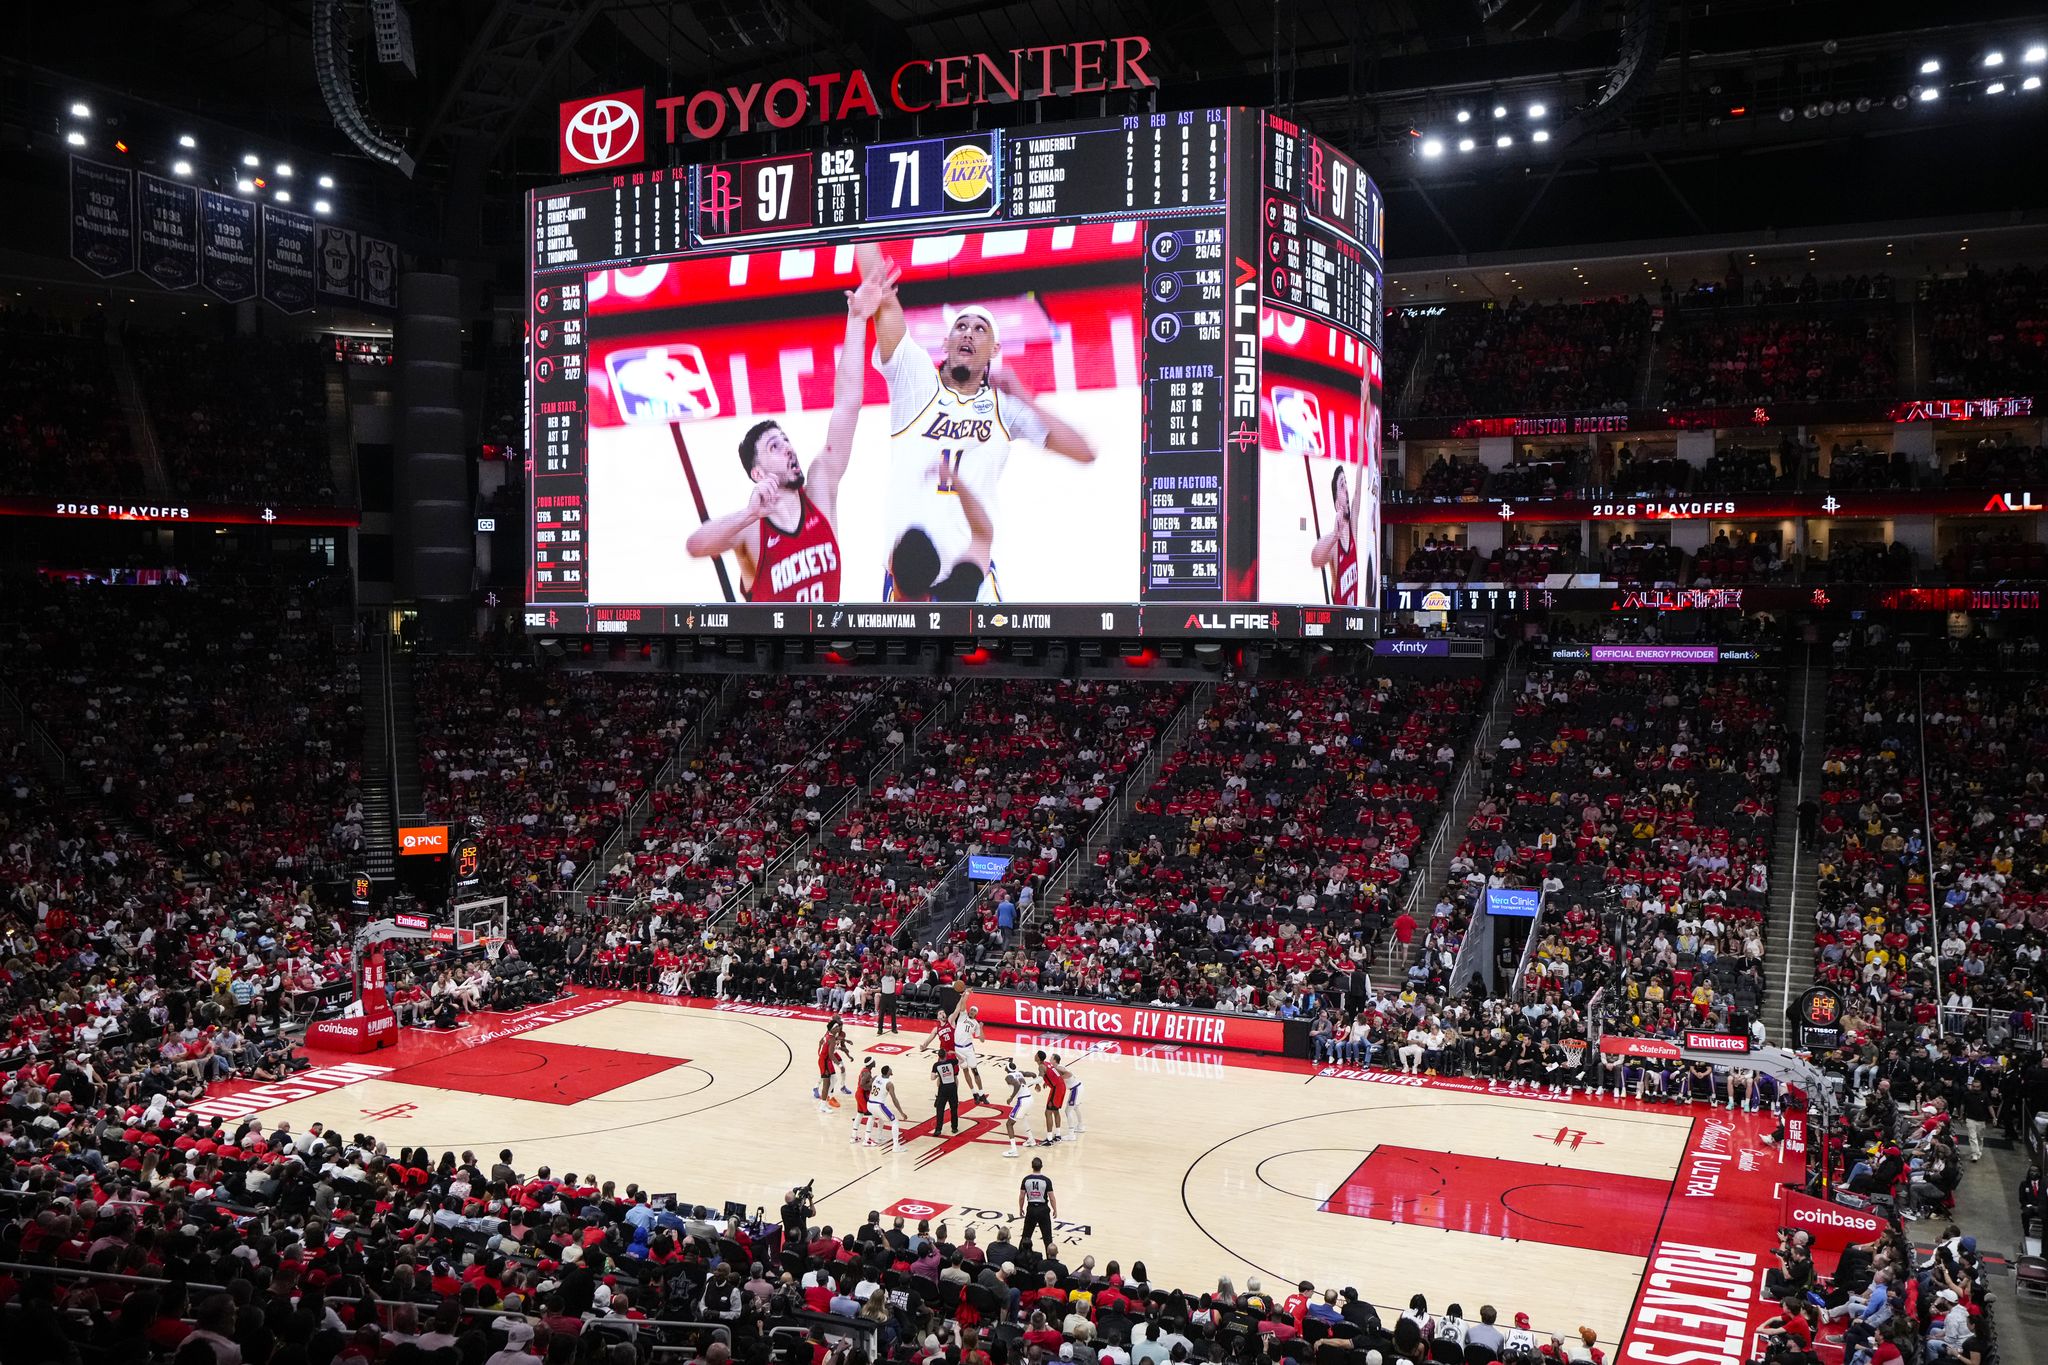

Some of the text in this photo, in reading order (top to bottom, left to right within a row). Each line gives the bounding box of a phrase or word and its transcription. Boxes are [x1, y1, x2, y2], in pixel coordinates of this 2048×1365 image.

[656, 35, 1155, 144] TOYOTA CENTER
[1123, 109, 1221, 129] PTS REB AST FLS
[1028, 136, 1077, 153] VANDERBILT
[821, 149, 855, 176] 8:52
[1015, 155, 1055, 170] 11 HAYES
[613, 168, 683, 188] PTS REB AST FLS
[889, 150, 920, 209] 71
[1014, 168, 1065, 186] 10 KENNARD
[757, 164, 794, 222] 97
[832, 183, 846, 197] TOL
[1013, 184, 1055, 201] 23 JAMES
[1332, 160, 1348, 219] 97
[547, 196, 571, 211] HOLIDAY
[832, 197, 846, 210] FLS
[1013, 200, 1057, 216] 36 SMART
[86, 204, 119, 222] WNBA
[547, 207, 586, 225] FINNEY-SMITH
[833, 210, 844, 223] CC
[75, 215, 129, 237] Champions
[153, 219, 184, 237] WNBA
[217, 223, 242, 238] 1999
[143, 231, 195, 253] Champions
[214, 234, 244, 251] WNBA
[279, 237, 302, 251] 2000
[547, 237, 565, 251] SMITH
[1160, 239, 1172, 254] 2P
[205, 246, 253, 265] Champions
[276, 248, 304, 264] WNBA
[547, 249, 578, 264] THOMPSON
[267, 259, 313, 278] Champions
[1160, 280, 1172, 294] 3P
[1202, 285, 1221, 300] 2/14
[1161, 320, 1171, 335] FT
[1198, 326, 1221, 341] 13/15
[1234, 256, 1257, 418] ALL FIRE
[540, 364, 548, 376] FT
[1159, 365, 1214, 380] TEAM STATS
[1170, 383, 1187, 397] REB
[541, 400, 577, 414] TEAM STATS
[1170, 399, 1187, 413] AST
[921, 412, 993, 442] LAKERS
[1170, 416, 1185, 429] STL
[1514, 415, 1629, 436] HOUSTON ROCKETS
[547, 430, 569, 442] AST 17
[1170, 432, 1186, 446] BLK
[547, 445, 558, 456] STL
[1153, 475, 1218, 490] FOUR FACTORS
[537, 495, 581, 508] FOUR FACTORS
[1152, 494, 1174, 507] EFG%
[1984, 492, 2043, 511] ALL
[57, 504, 190, 518] 2026 PLAYOFFS
[1593, 502, 1736, 516] 2026 PLAYOFFS
[479, 520, 494, 531] CC
[1152, 517, 1181, 531] OREB%
[1152, 540, 1168, 554] FTR
[770, 542, 837, 595] ROCKETS
[1152, 564, 1175, 577] TOV%
[1399, 591, 1412, 609] 71
[1972, 590, 2040, 609] HOUSTON
[597, 609, 641, 621] DAILY LEADERS
[674, 613, 784, 628] 1. J. ALLEN 15
[817, 613, 941, 629] 2. V. WEMBANYAMA 12
[977, 613, 1114, 630] 3. D. AYTON 10
[1184, 614, 1269, 629] ALL FIRE
[596, 620, 628, 633] REBOUNDS
[1392, 641, 1428, 653] xfinity
[1553, 648, 1748, 660] reliant OFFICIAL ENERGY PROVIDER reliant
[417, 835, 442, 846] PNC
[460, 857, 477, 876] 24
[971, 860, 986, 870] Vera
[356, 887, 367, 896] 24
[1490, 894, 1535, 906] Vera Clinic
[397, 915, 427, 928] Emirates
[1813, 997, 1835, 1008] 8:52
[467, 999, 623, 1045] Michelob ULTRA
[1014, 999, 1226, 1044] Emirates FLY BETTER
[1811, 1008, 1831, 1021] 24
[318, 1022, 359, 1036] coinbase
[370, 1016, 393, 1032] PLAYOFFS
[1814, 1027, 1839, 1035] TISSOT
[1689, 1034, 1745, 1049] Emirates
[941, 1065, 950, 1073] 24
[871, 1085, 881, 1097] 36
[1335, 1069, 1428, 1087] PLAYOFFS
[1432, 1080, 1473, 1090] Presented
[1487, 1087, 1572, 1101] Google
[1789, 1120, 1803, 1130] GET
[1789, 1130, 1802, 1140] THE
[1791, 1140, 1805, 1153] App
[1032, 1181, 1039, 1191] 14
[1685, 1160, 1722, 1197] ULTRA
[1793, 1208, 1877, 1231] coinbase
[1288, 1303, 1296, 1314] 7
[1626, 1241, 1757, 1365] ROCKETS
